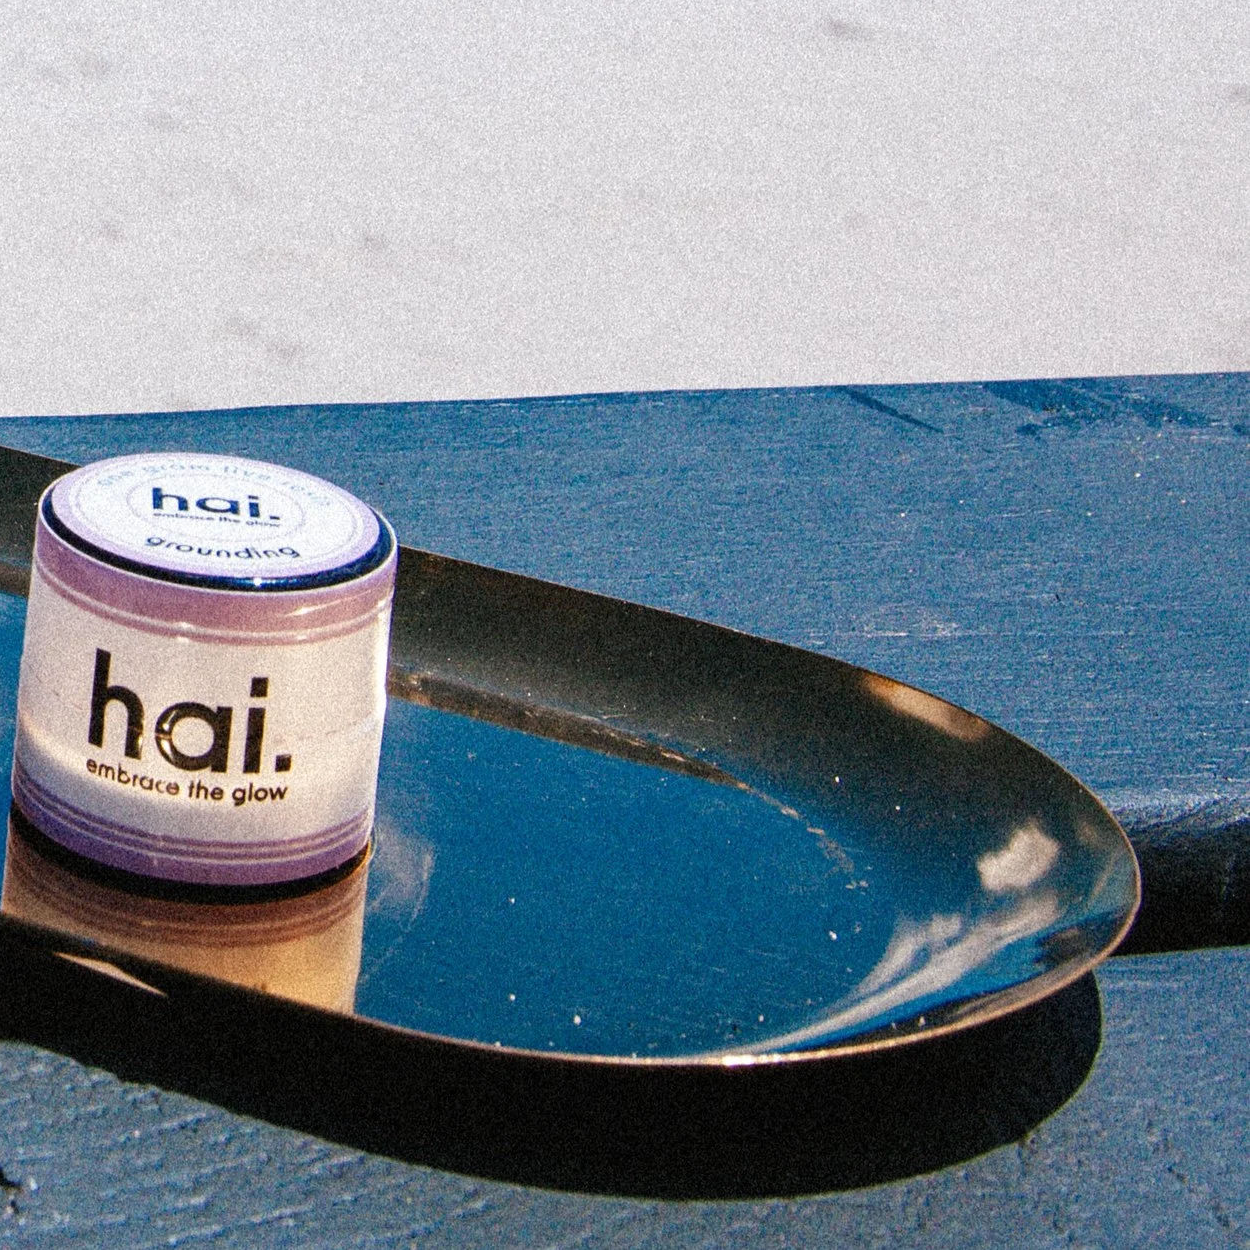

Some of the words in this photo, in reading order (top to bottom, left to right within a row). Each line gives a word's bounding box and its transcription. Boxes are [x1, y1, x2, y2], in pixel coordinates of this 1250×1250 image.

[152, 487, 281, 521] hai.
[218, 515, 241, 524] the
[144, 536, 301, 560] grounding
[88, 648, 292, 774] hai.
[86, 757, 180, 796] embrace
[188, 780, 224, 802] the
[232, 783, 289, 807] glow
